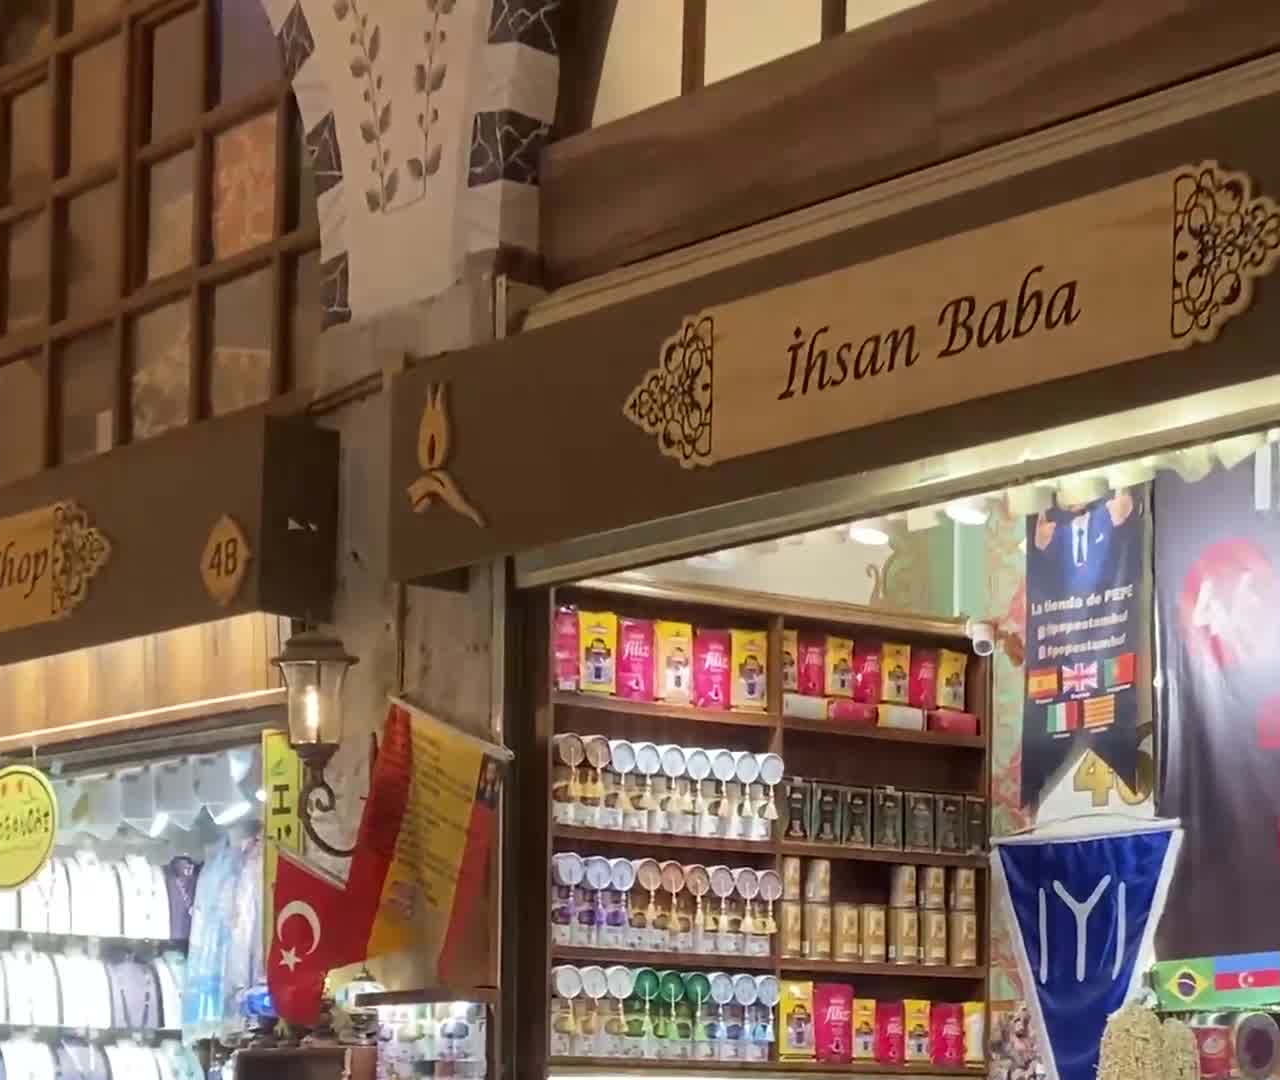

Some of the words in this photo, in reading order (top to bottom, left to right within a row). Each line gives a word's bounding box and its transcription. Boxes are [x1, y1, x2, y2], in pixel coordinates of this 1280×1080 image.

[777, 325, 919, 402] İhsan
[936, 263, 1082, 361] Baba
[209, 537, 238, 577] 48
